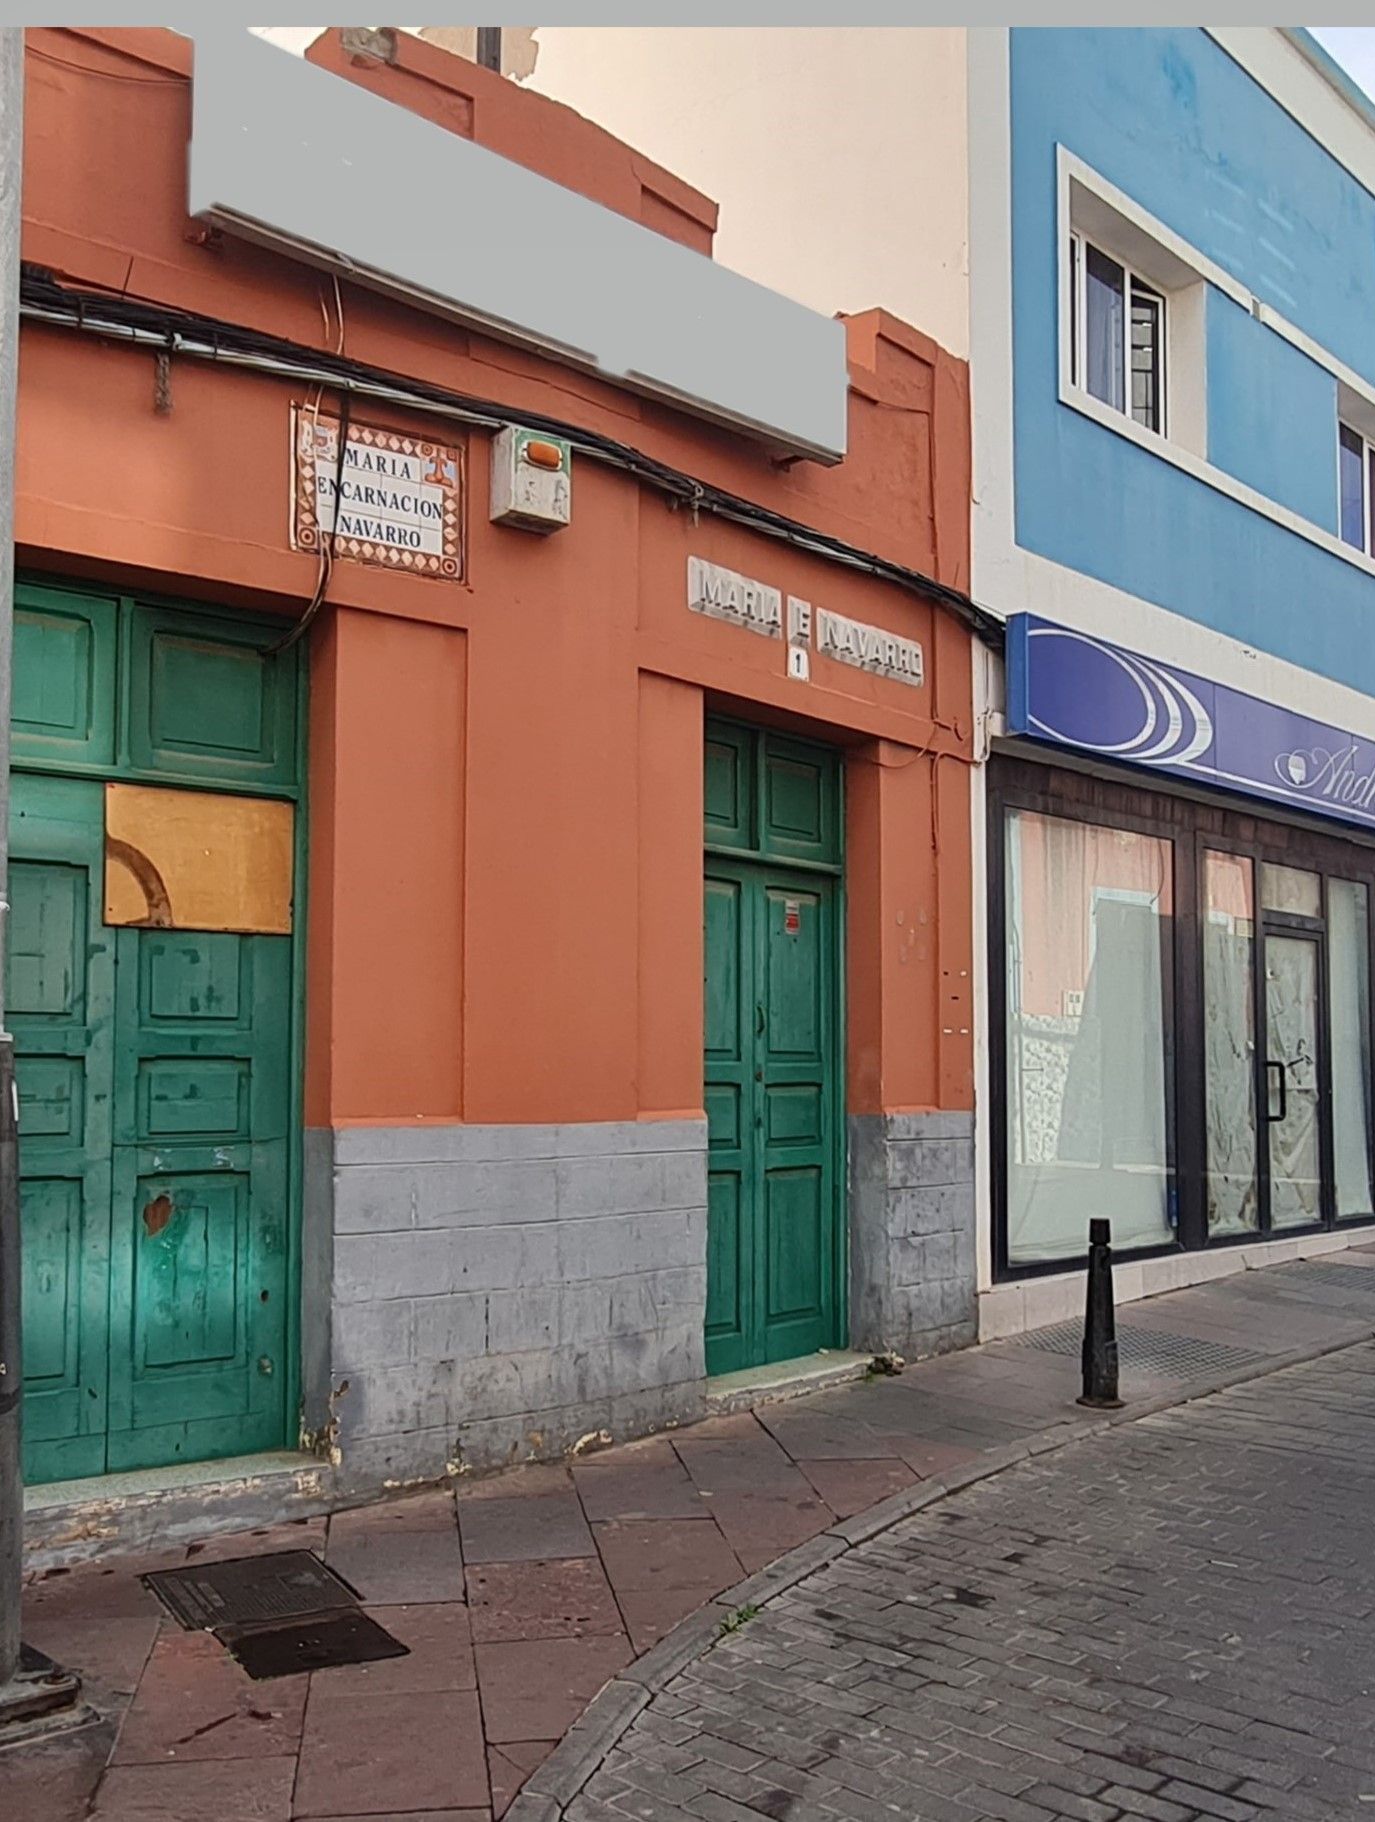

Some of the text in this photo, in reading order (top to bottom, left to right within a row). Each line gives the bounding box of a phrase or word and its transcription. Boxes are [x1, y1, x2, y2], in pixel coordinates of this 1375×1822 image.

[346, 448, 411, 479] MARIA
[317, 476, 444, 520] ENCARNACION
[340, 515, 421, 548] NAVARRO
[699, 568, 922, 677] MARIA E NAVARRO
[794, 652, 802, 673] 1
